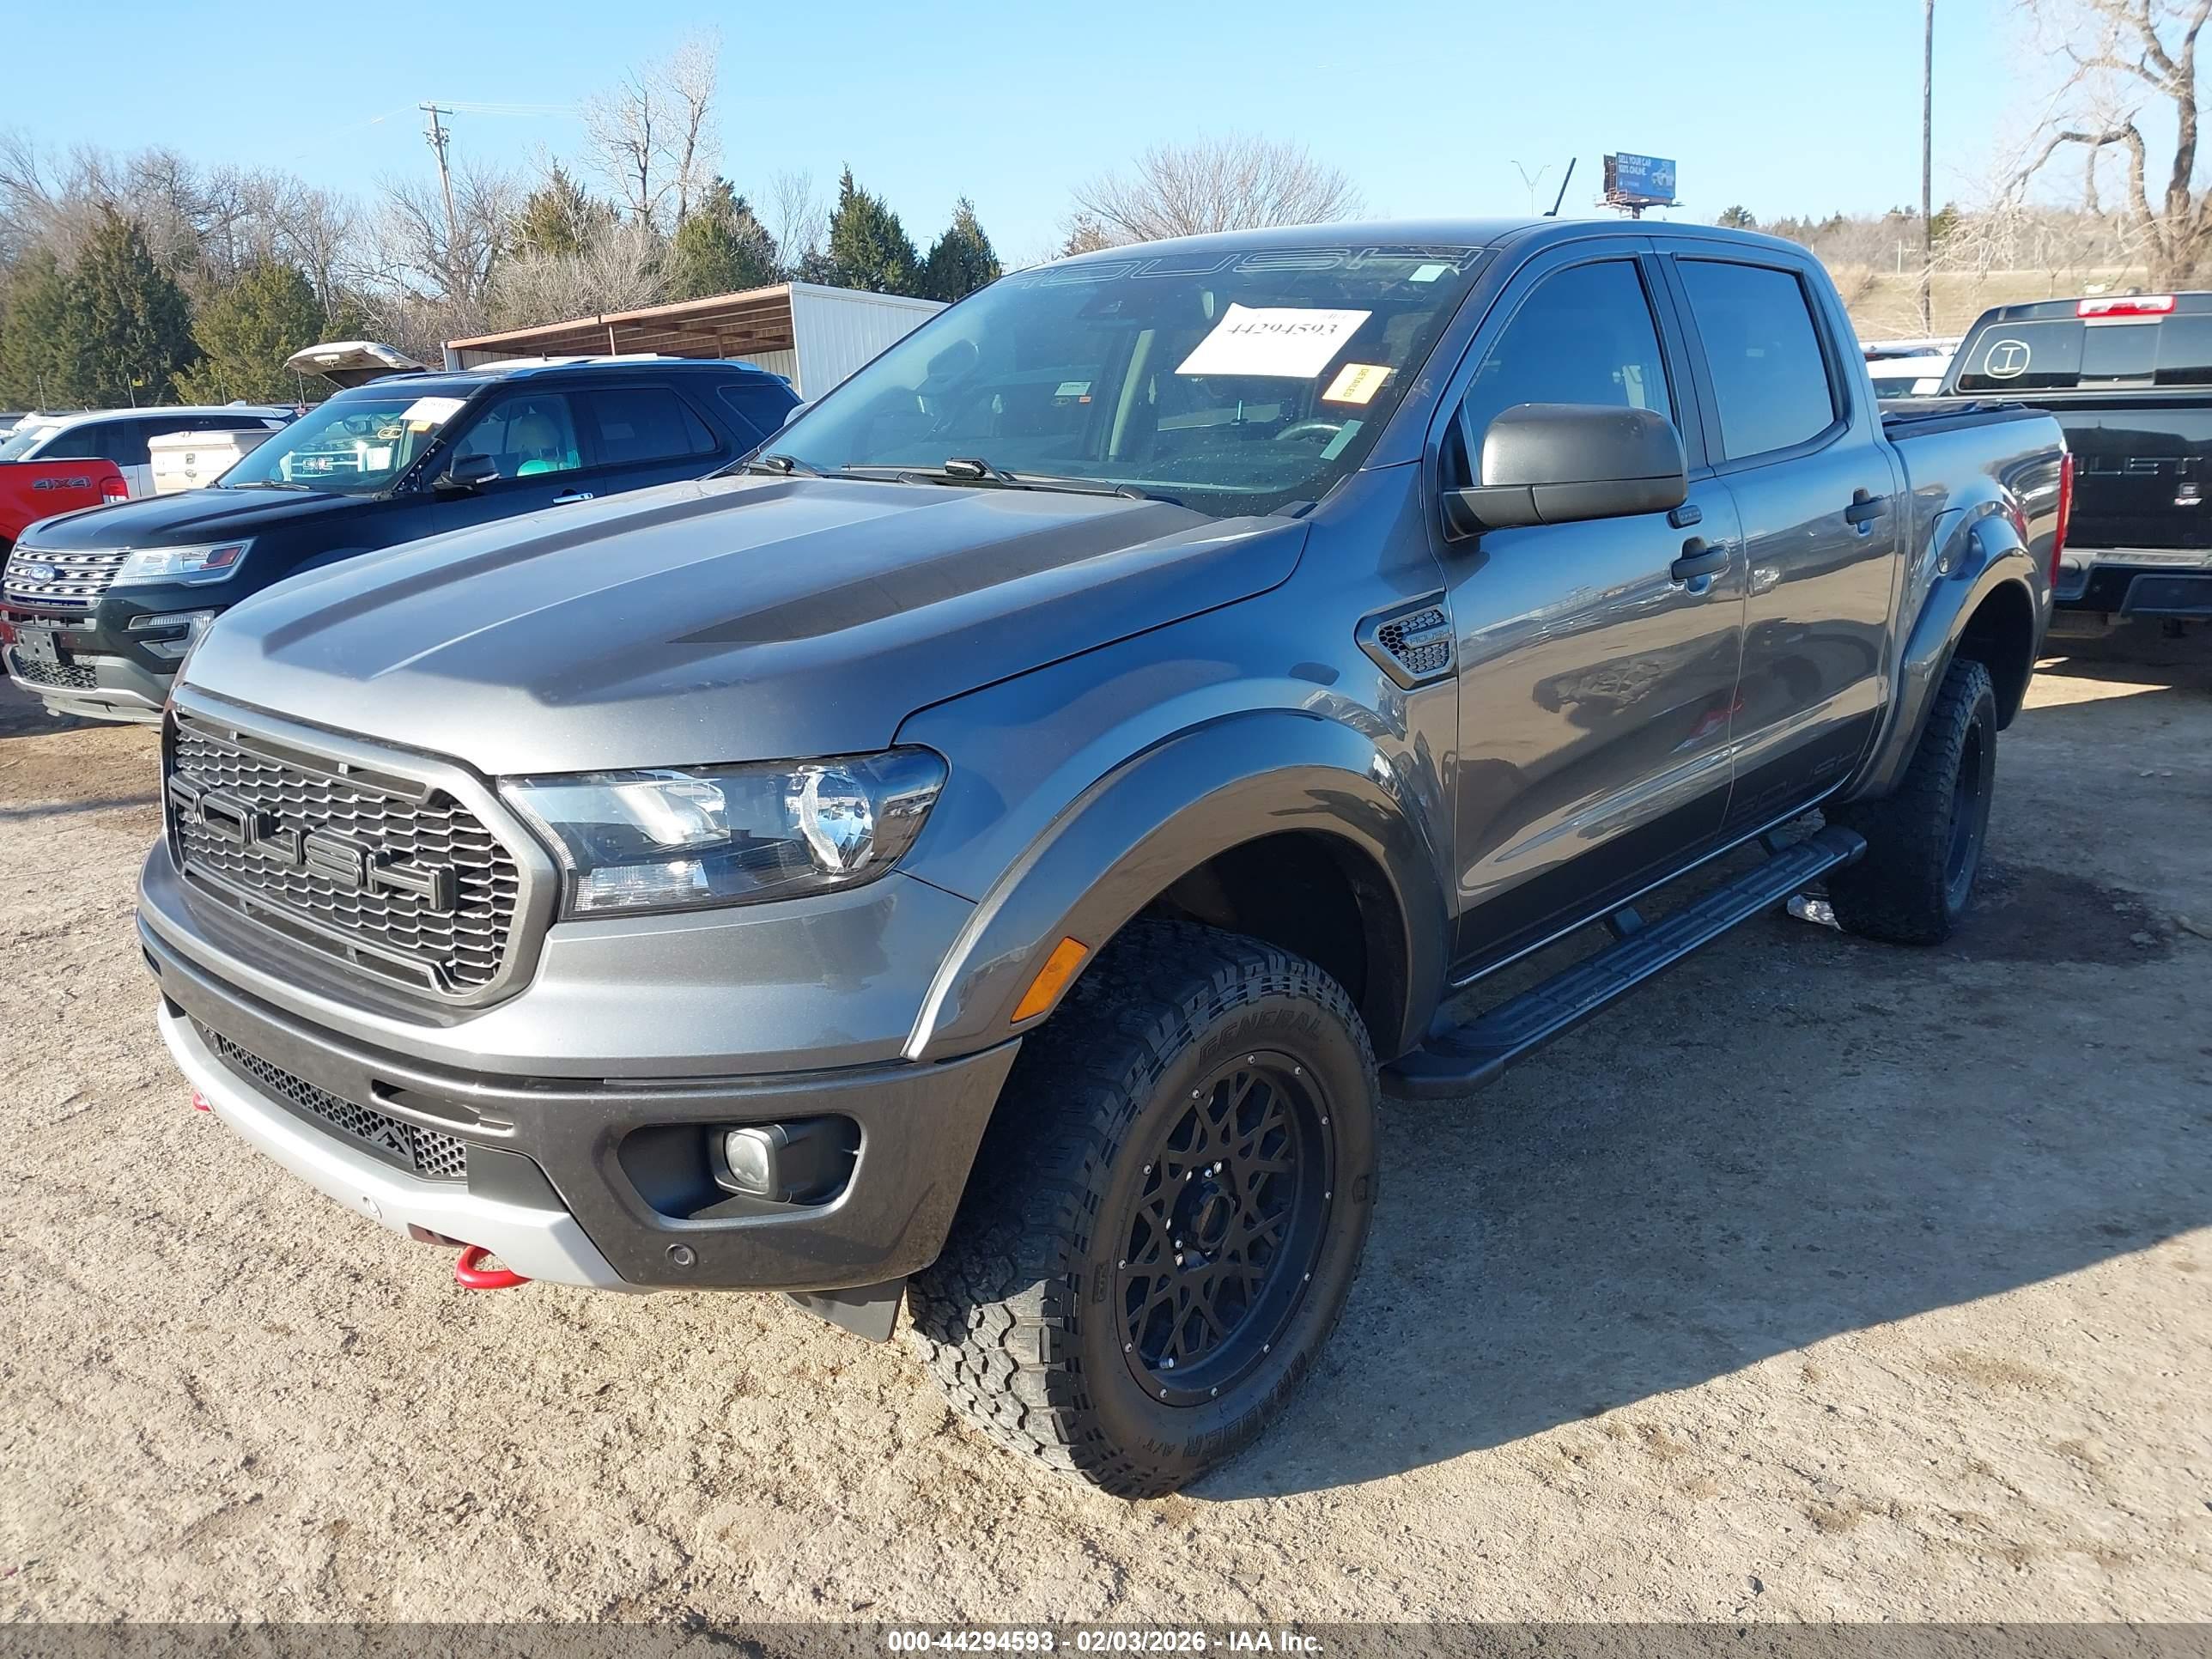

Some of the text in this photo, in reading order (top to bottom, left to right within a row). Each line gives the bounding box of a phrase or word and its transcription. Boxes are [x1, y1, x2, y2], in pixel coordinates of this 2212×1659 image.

[1618, 155, 1628, 164] SELL
[1629, 156, 1641, 166] YOUR
[1226, 323, 1338, 335] 44294593
[1343, 368, 1370, 398] DETAILED
[302, 457, 333, 471] GMC
[168, 772, 458, 911] ROUSH
[1198, 1009, 1321, 1065] GENERAL
[1182, 1351, 1306, 1456] GRABBER
